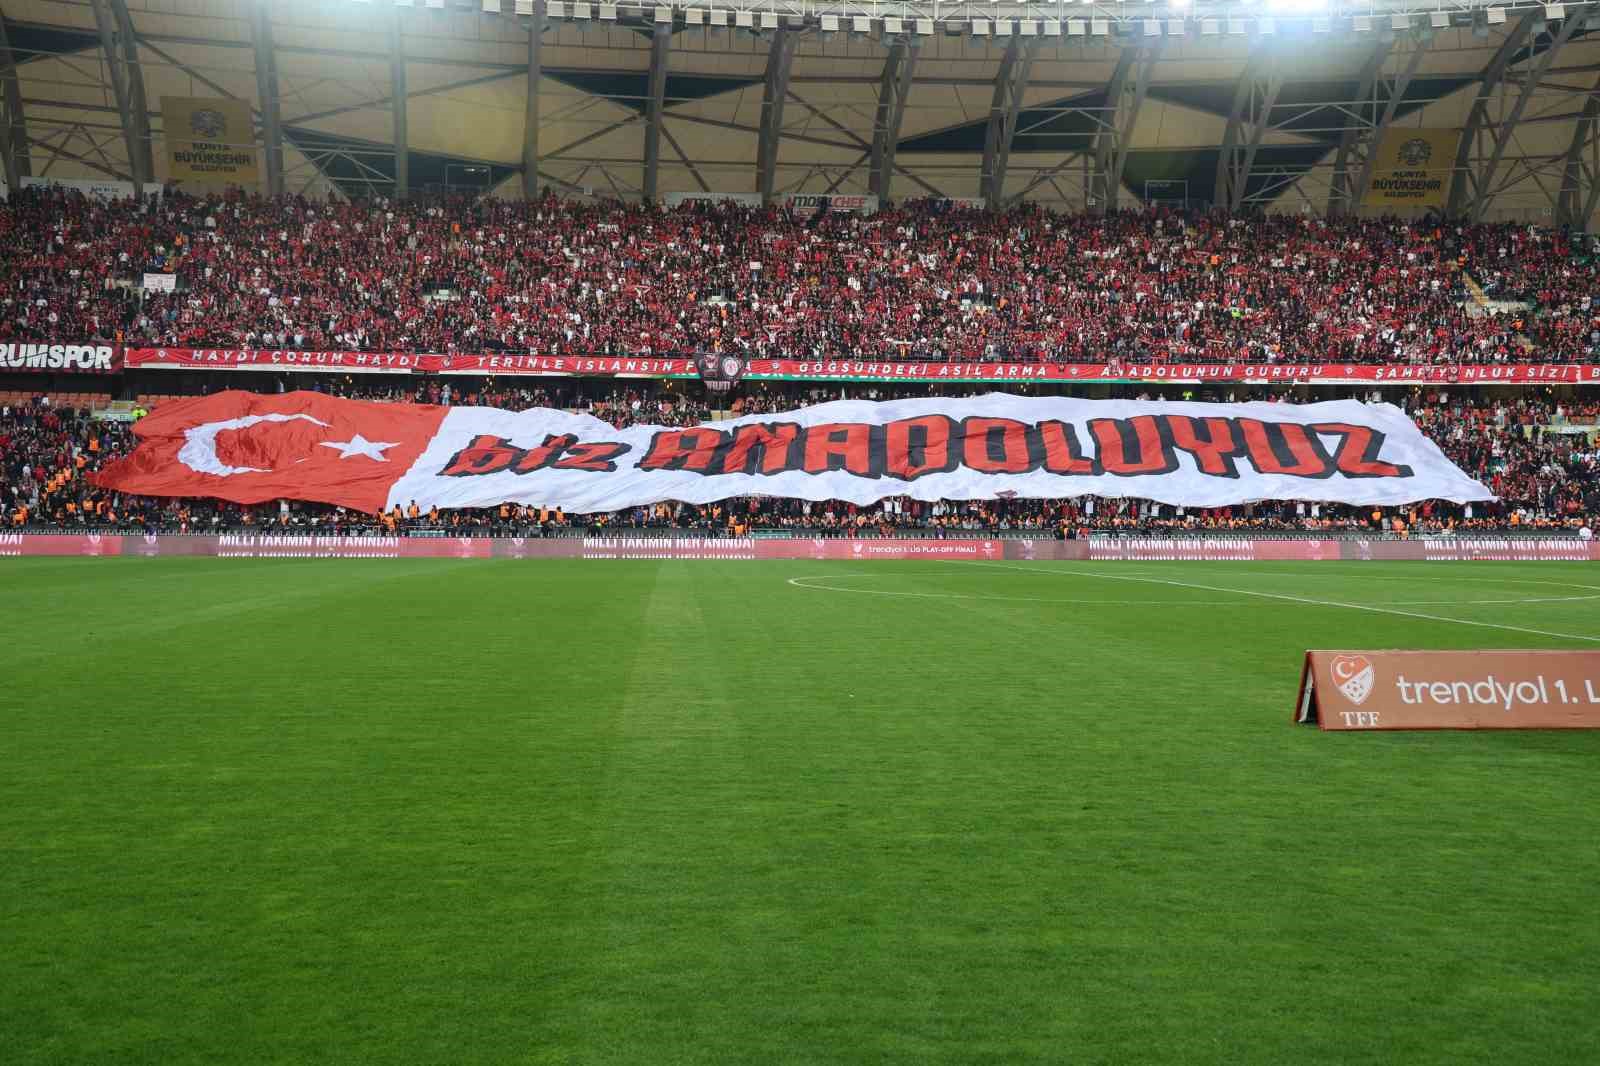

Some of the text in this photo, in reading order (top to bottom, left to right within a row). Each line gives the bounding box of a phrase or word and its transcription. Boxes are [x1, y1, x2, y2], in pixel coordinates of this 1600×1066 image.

[994, 365, 1046, 376] ARMA
[1245, 366, 1322, 377] GURURU
[634, 414, 1414, 482] ANADOLUYUZ
[1396, 676, 1548, 710] trendyol
[1554, 679, 1578, 703] 1.
[1339, 712, 1380, 726] TFF
